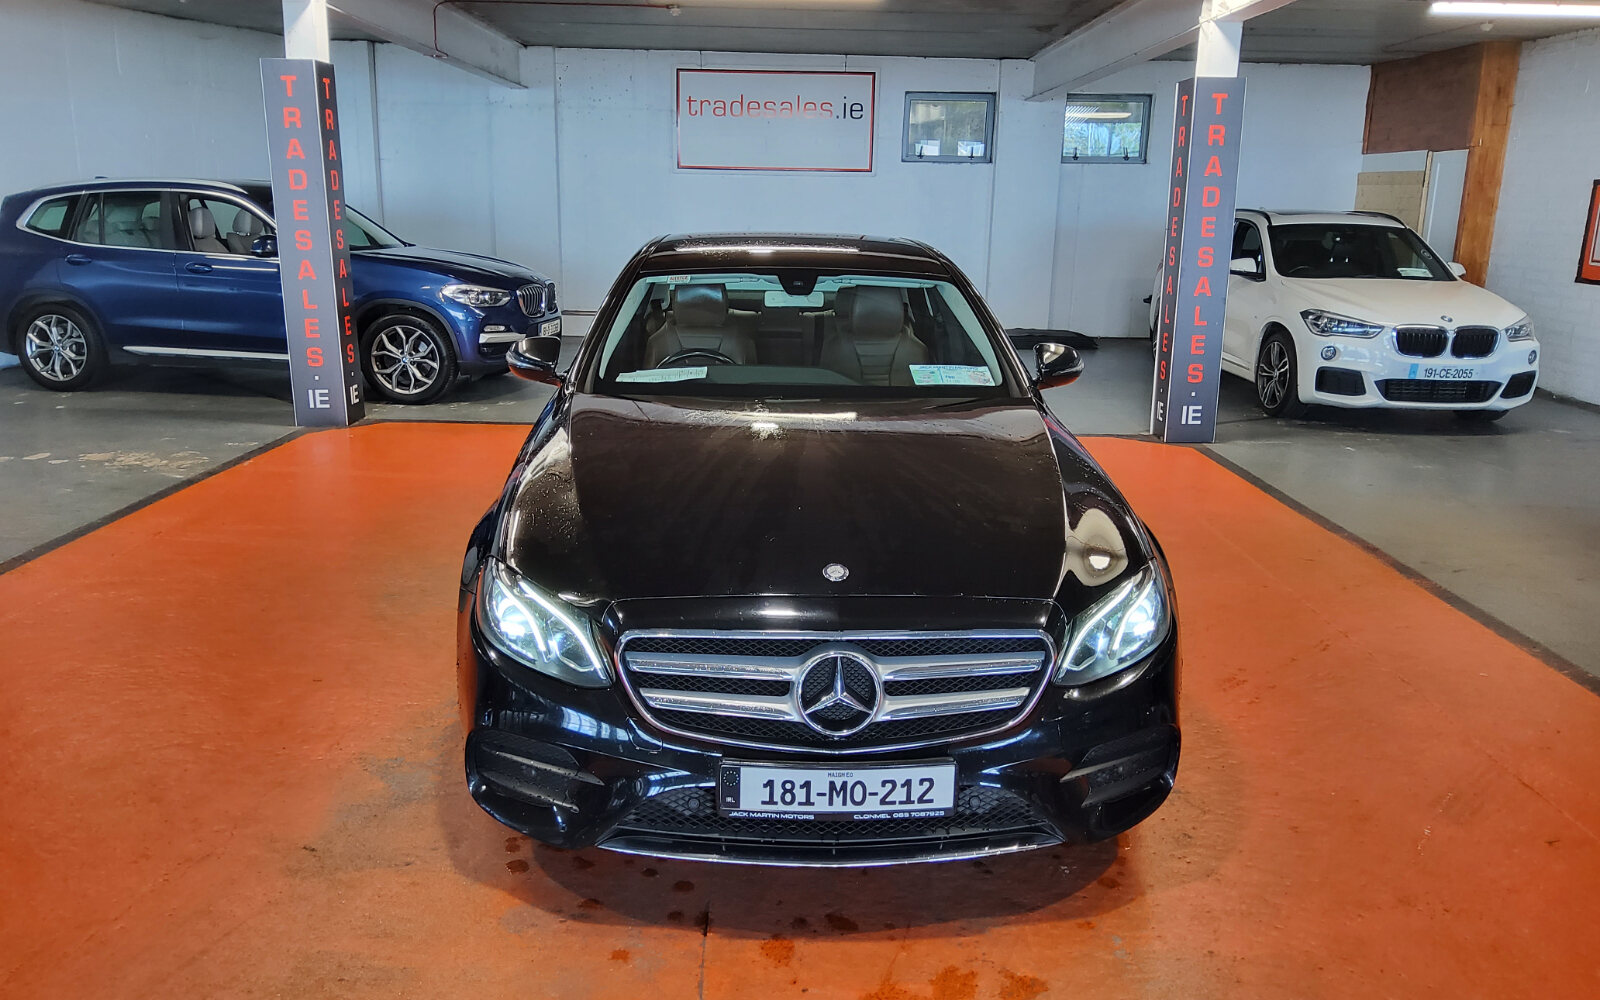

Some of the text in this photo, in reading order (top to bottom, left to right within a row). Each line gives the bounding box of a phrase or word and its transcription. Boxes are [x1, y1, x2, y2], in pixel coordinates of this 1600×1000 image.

[686, 94, 865, 120] tradesales.ie
[1424, 367, 1474, 379] 191-CE-2055
[760, 778, 935, 807] 181-MO-212
